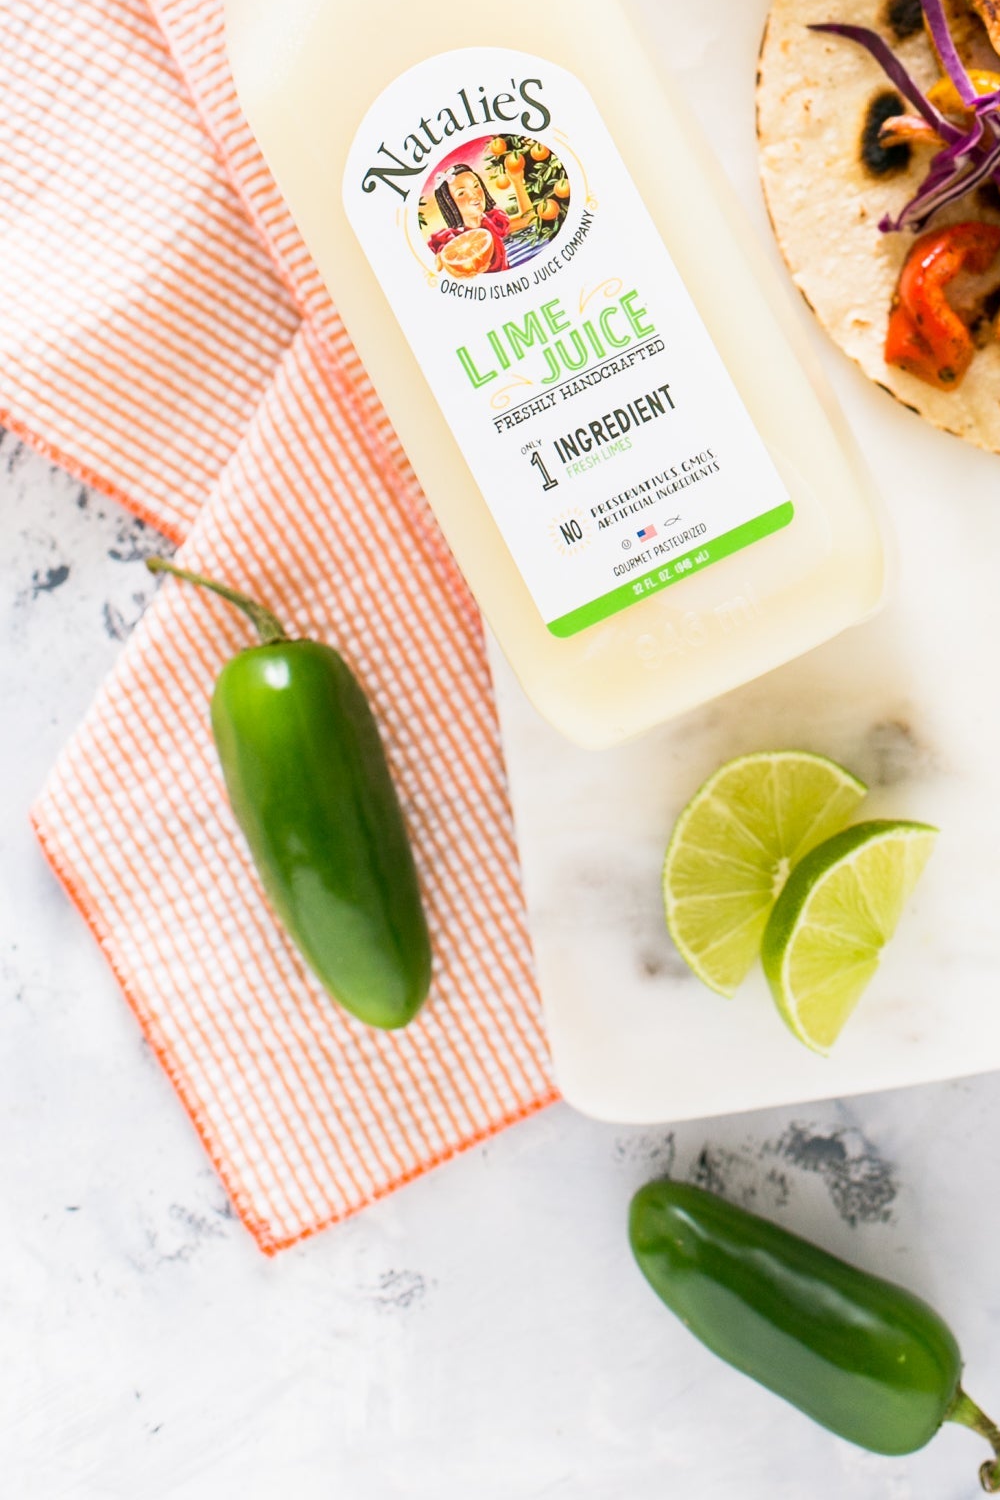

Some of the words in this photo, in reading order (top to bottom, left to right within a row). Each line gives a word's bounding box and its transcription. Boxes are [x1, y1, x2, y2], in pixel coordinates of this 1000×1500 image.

[440, 279, 486, 301] ORCHID
[490, 277, 530, 300] ISLAND
[533, 256, 563, 285] JUICE
[561, 209, 595, 262] COMPANY
[456, 298, 571, 389] LIME
[541, 289, 656, 384] JUICE
[494, 394, 558, 434] FRESHLY
[559, 339, 666, 401] HANDCRAFTED
[520, 439, 543, 455] ONLY
[530, 451, 559, 491] 1
[553, 384, 676, 464] INGREDIENT
[565, 455, 601, 478] FRESH
[602, 436, 633, 460] LIMES
[597, 495, 656, 531] ARTIFICIAL
[656, 460, 720, 500] INGREDIENTS
[559, 519, 583, 545] NO
[613, 550, 654, 577] GOURMET
[653, 522, 707, 557] PASTEURIZED
[632, 582, 645, 596] 32
